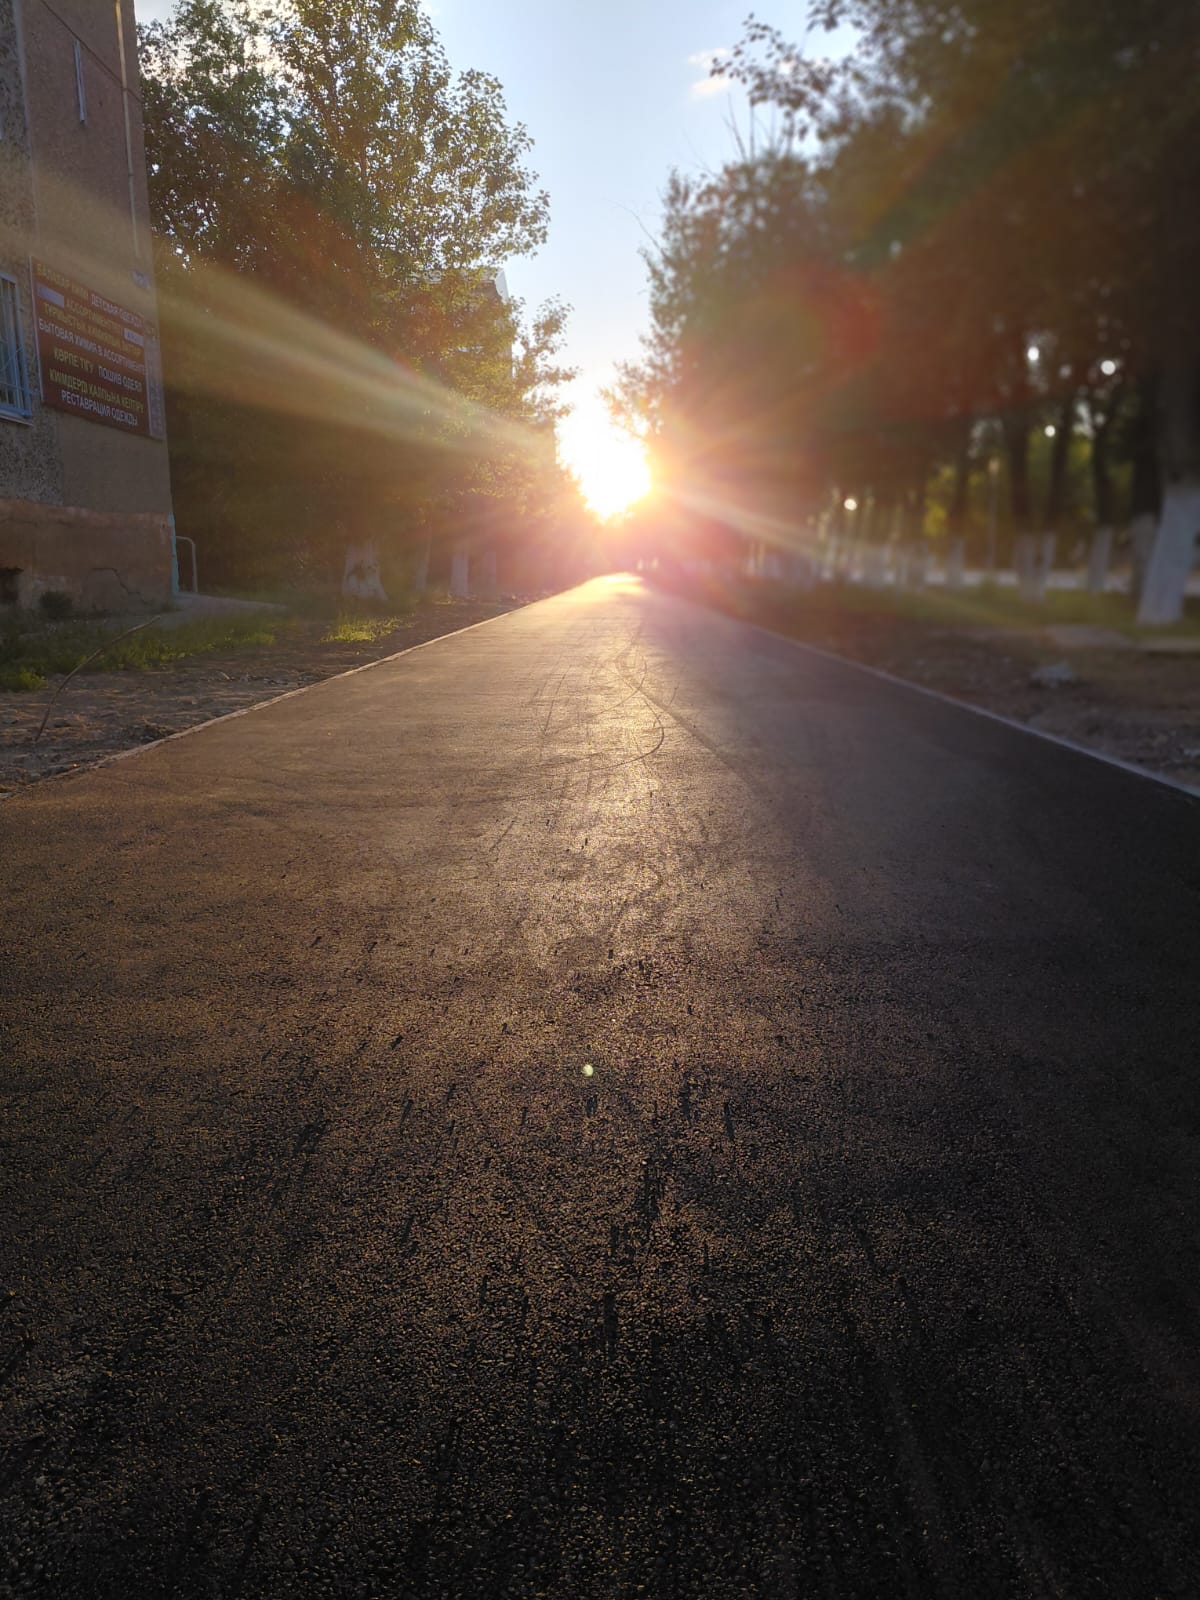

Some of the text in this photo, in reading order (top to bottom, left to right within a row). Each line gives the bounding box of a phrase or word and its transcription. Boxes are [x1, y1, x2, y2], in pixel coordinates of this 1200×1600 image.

[38, 319, 74, 343] БЫТОВАЯ
[74, 335, 97, 353] ХИМИЯ
[98, 366, 122, 384] ПОШИВ
[61, 390, 138, 426] РЕСТАВРАЦИЯ ОДЕЖДЫ
